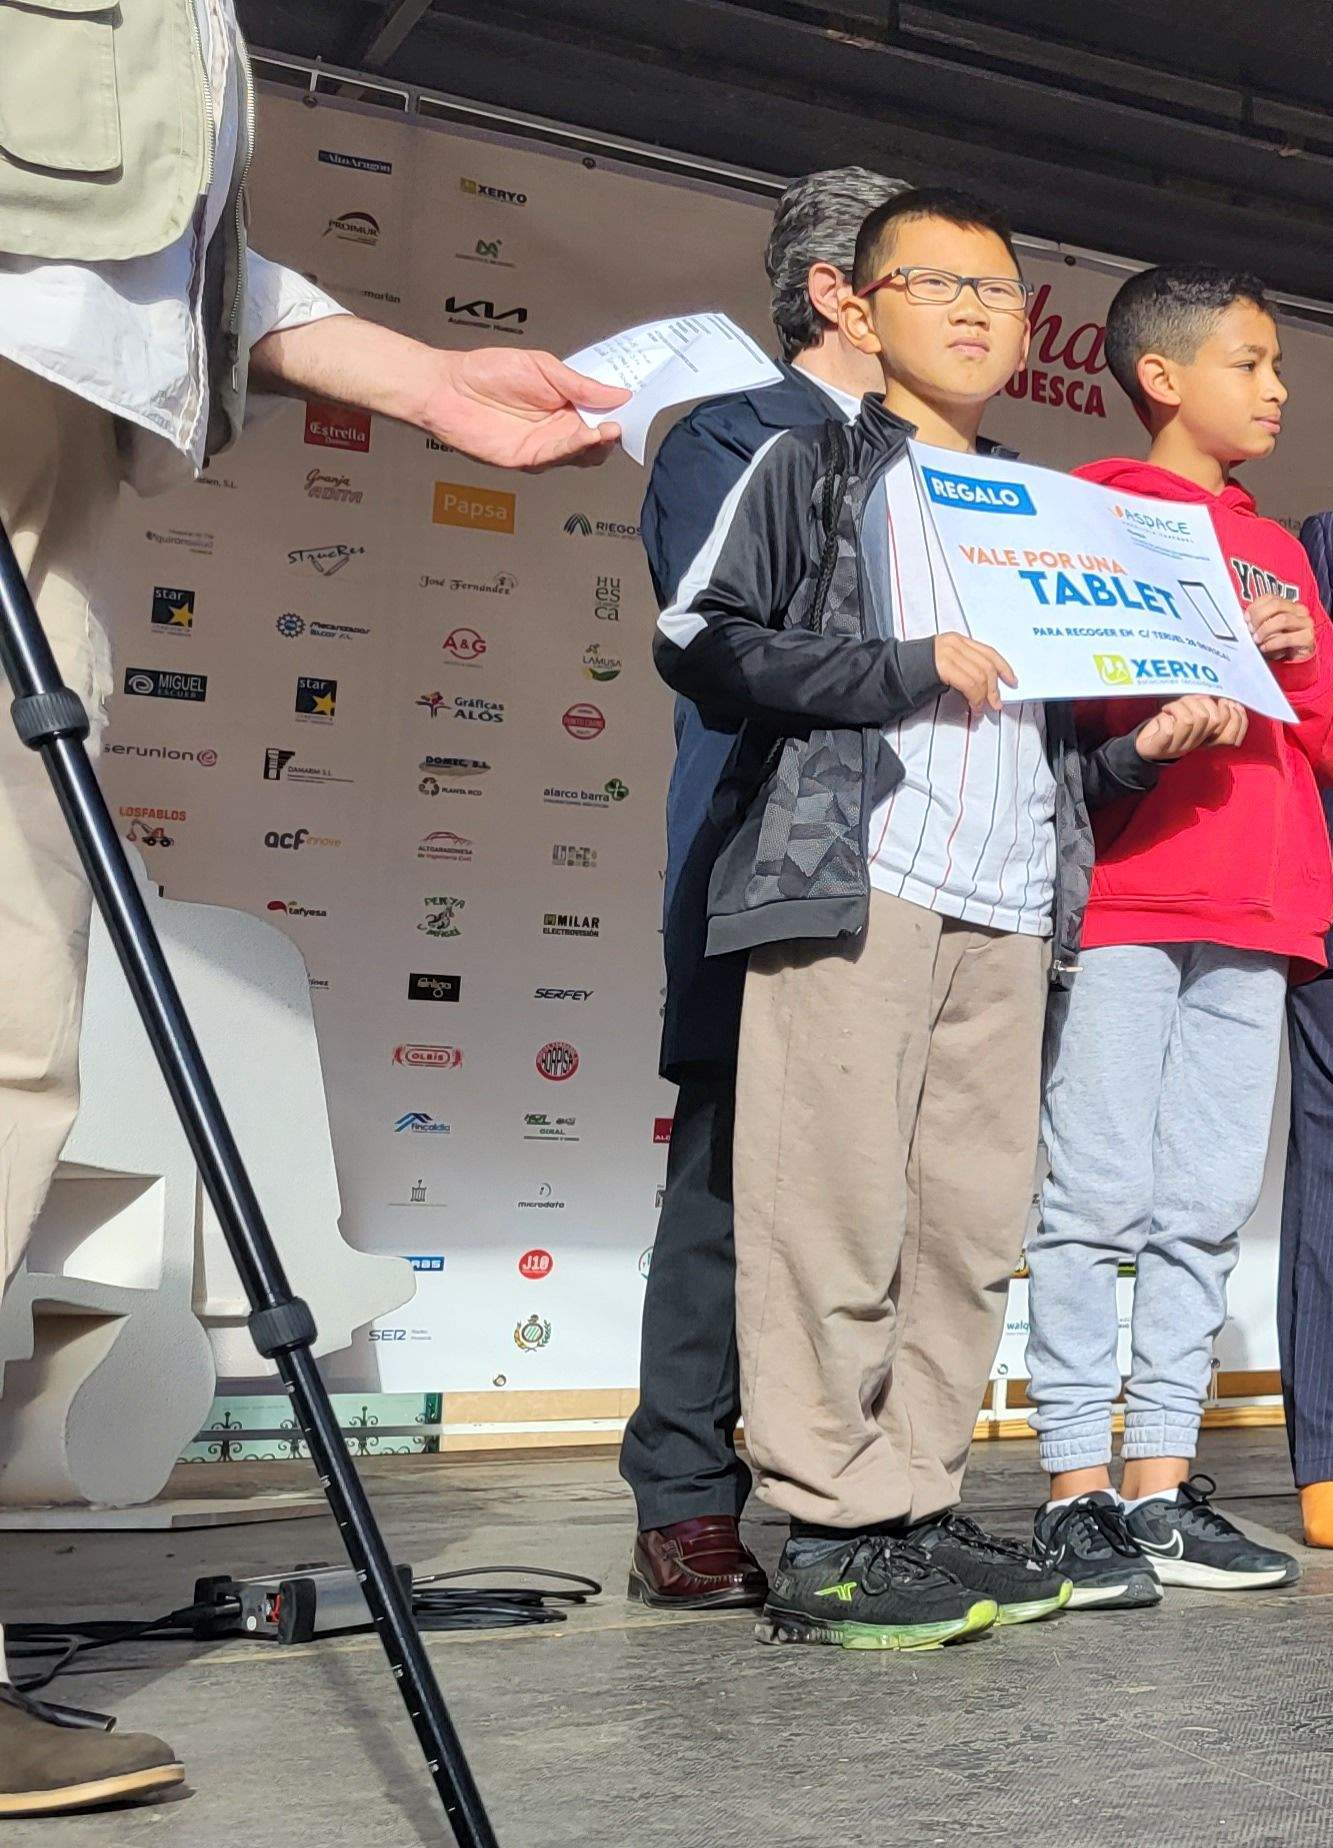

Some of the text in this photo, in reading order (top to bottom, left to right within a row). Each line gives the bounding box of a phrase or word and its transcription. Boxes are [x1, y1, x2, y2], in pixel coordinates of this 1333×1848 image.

[478, 185, 527, 203] XERYO
[445, 297, 527, 323] KIA
[1001, 368, 1107, 419] UESCA
[309, 422, 366, 442] Estrella
[306, 468, 351, 488] Granja
[931, 478, 1020, 508] REGALO
[444, 493, 508, 522] Papsa
[958, 544, 1128, 576] VALE POR UNA
[155, 587, 184, 601] star
[1018, 569, 1182, 621] TABLET
[1032, 627, 1063, 637] PARA
[1066, 627, 1117, 638] RECOGER
[1119, 629, 1134, 637] EN
[583, 655, 622, 668] LAMUSA
[1130, 658, 1219, 684] XERYO
[158, 673, 204, 692] MIGUEL
[299, 677, 326, 691] star
[454, 696, 505, 712] Gráficas
[454, 709, 504, 723] ALÓS
[580, 790, 610, 802] barra
[264, 828, 309, 850] acf
[289, 905, 327, 918] tafyesa
[557, 916, 600, 929] MILAR
[534, 988, 594, 1001] SERFEY
[368, 1329, 407, 1342] SER
